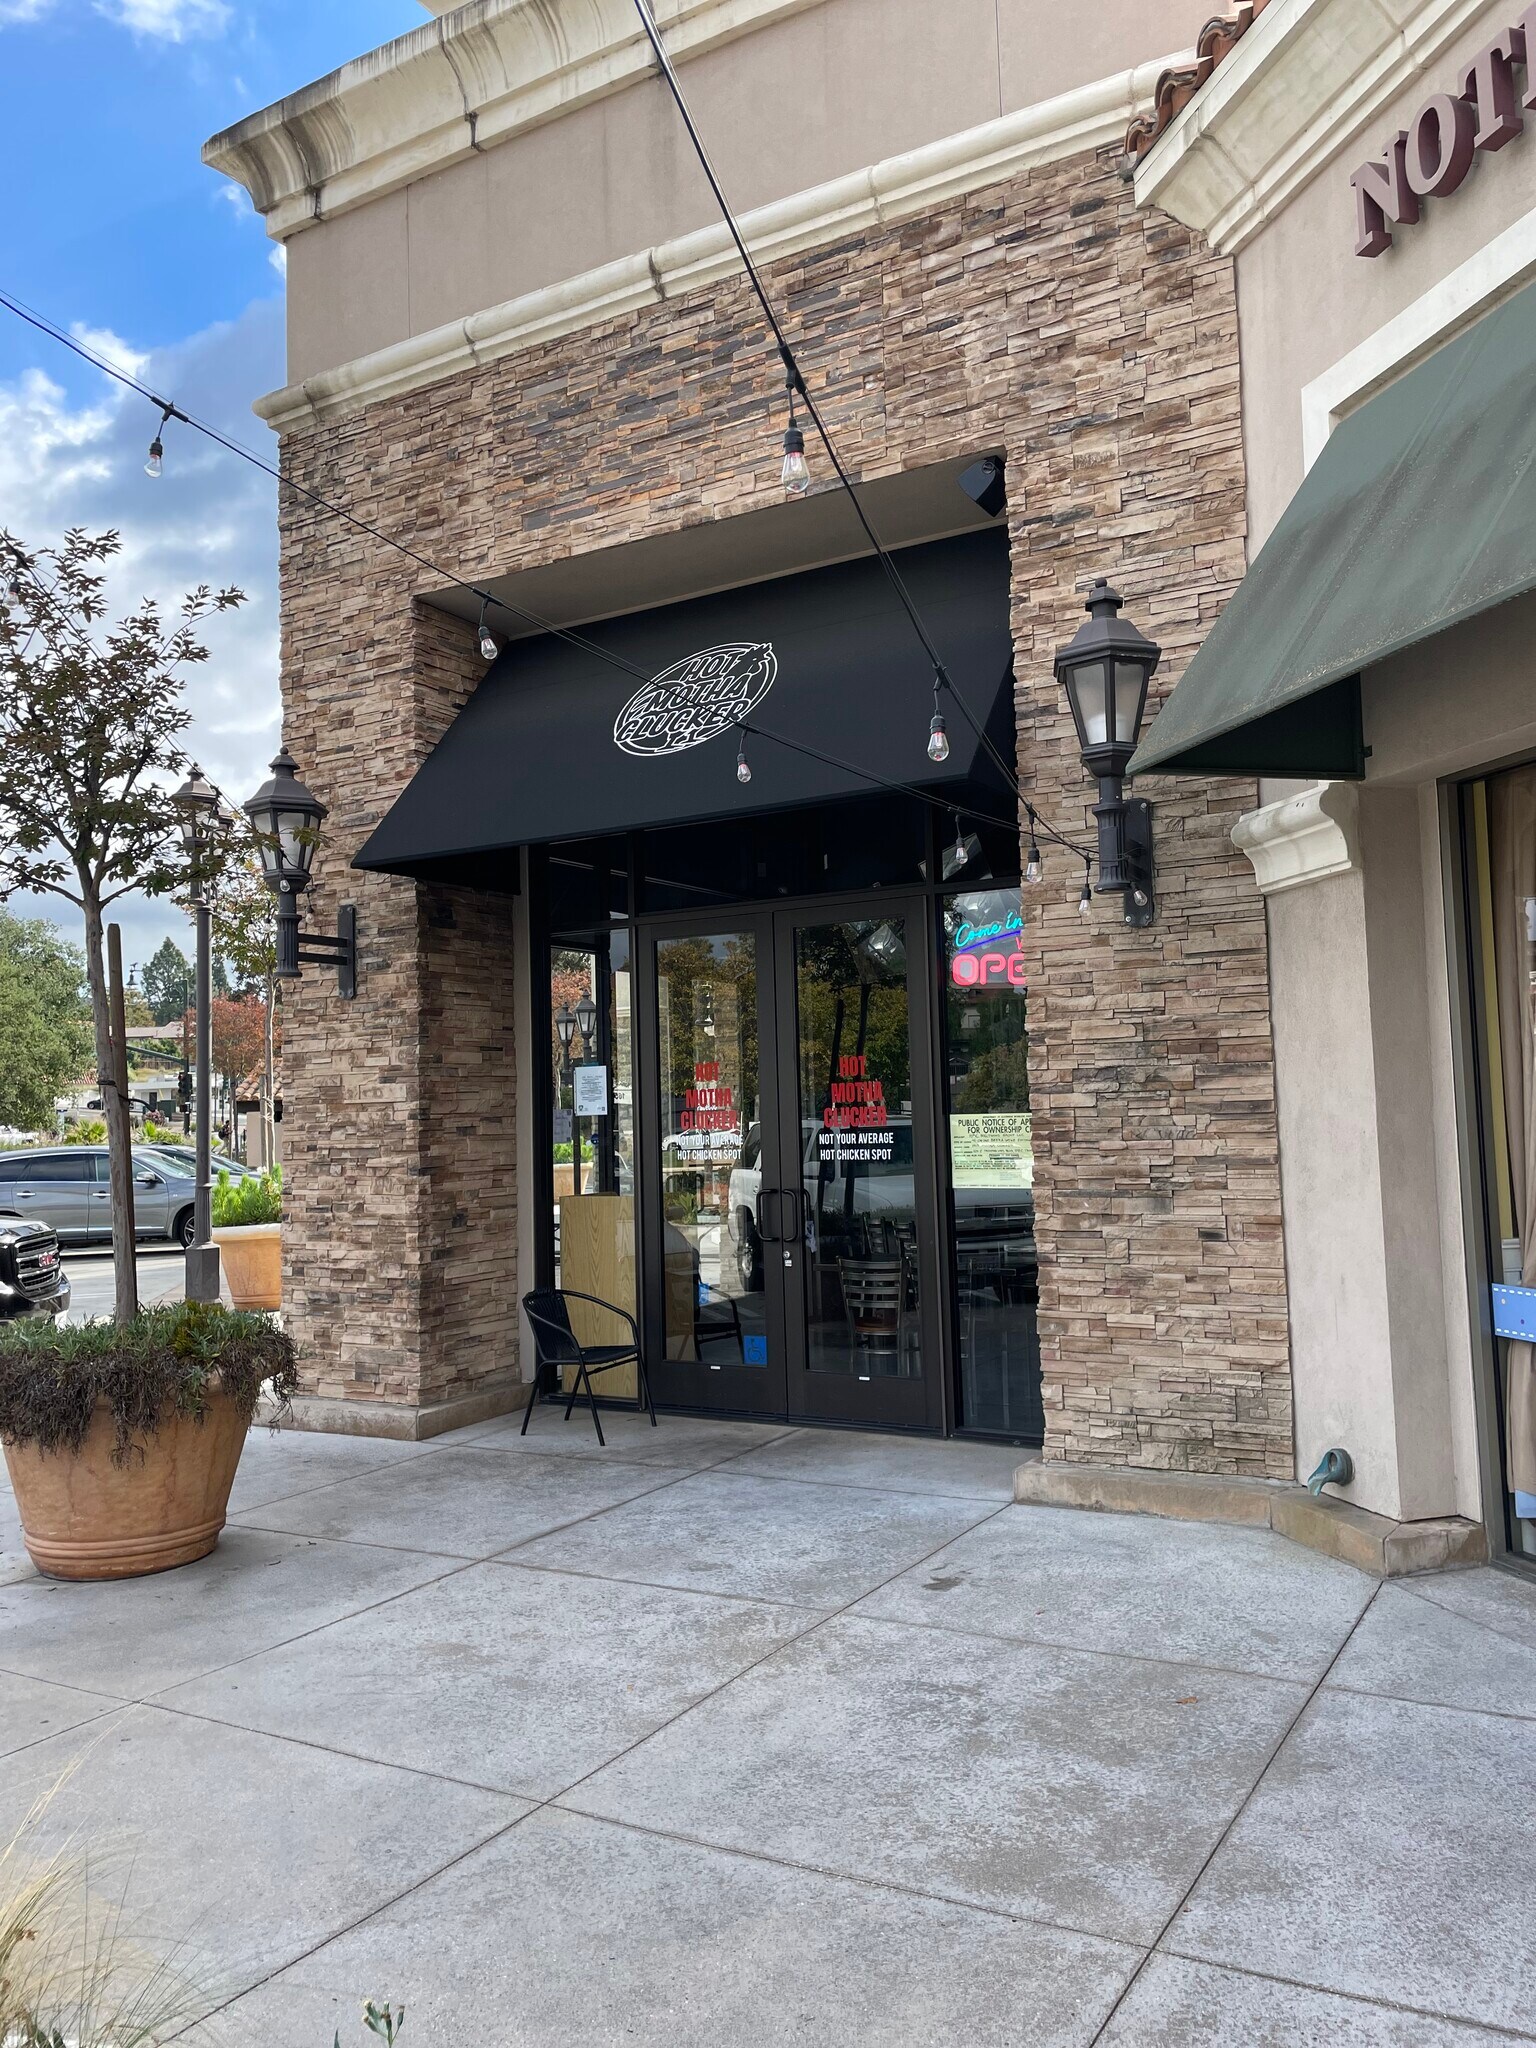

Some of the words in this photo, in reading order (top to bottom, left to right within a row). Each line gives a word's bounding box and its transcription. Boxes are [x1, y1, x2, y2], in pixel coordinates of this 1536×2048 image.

[679, 650, 746, 682] HOT
[643, 673, 752, 713] MOTHA
[616, 699, 752, 742] CLUCKER
[956, 923, 1001, 947] Come
[1006, 912, 1023, 929] in
[695, 1061, 720, 1081] HOT
[839, 1056, 867, 1077] HOT
[685, 1088, 733, 1108] MOTHA
[831, 1081, 883, 1103] MOTHA
[681, 1110, 737, 1130] CLUCKER
[824, 1105, 887, 1128] CLUCKER
[958, 1119, 979, 1127] PUBLIC
[982, 1118, 1005, 1126] NOTICE
[1008, 1118, 1017, 1126] OF
[819, 1133, 835, 1145] NOT
[835, 1132, 857, 1145] YOUR
[858, 1132, 894, 1144] AVERAGE
[968, 1126, 980, 1134] FOR
[983, 1125, 1022, 1134] OWNERSHIP
[677, 1135, 690, 1146] NOT
[690, 1134, 710, 1146] YOUR
[710, 1134, 743, 1146] AVERAGE
[677, 1149, 690, 1160] HOT
[692, 1149, 722, 1160] CHICKEN
[723, 1149, 742, 1160] SPOT
[820, 1149, 835, 1161] HOT
[836, 1149, 871, 1161] CHICKEN
[871, 1148, 892, 1160] SPOT
